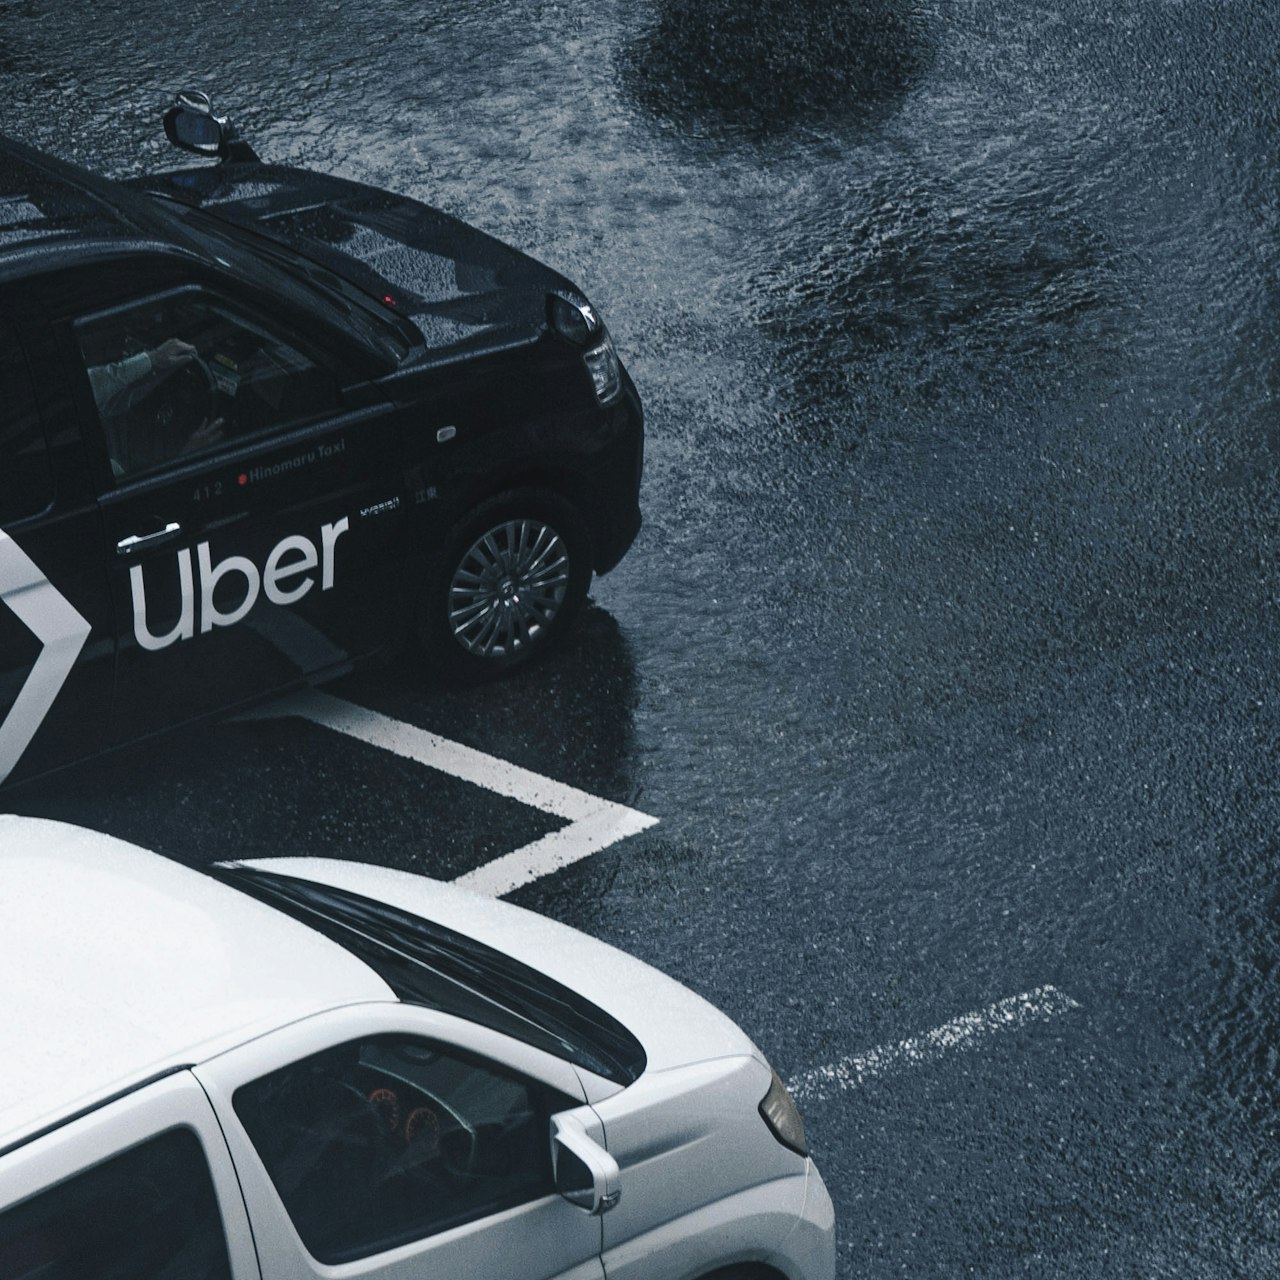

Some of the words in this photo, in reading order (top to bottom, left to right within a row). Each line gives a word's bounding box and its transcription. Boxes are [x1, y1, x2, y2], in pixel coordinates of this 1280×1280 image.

[249, 452, 315, 483] Hinomaru
[318, 438, 346, 457] Taxi
[193, 481, 223, 502] 412
[129, 516, 349, 651] Uber
